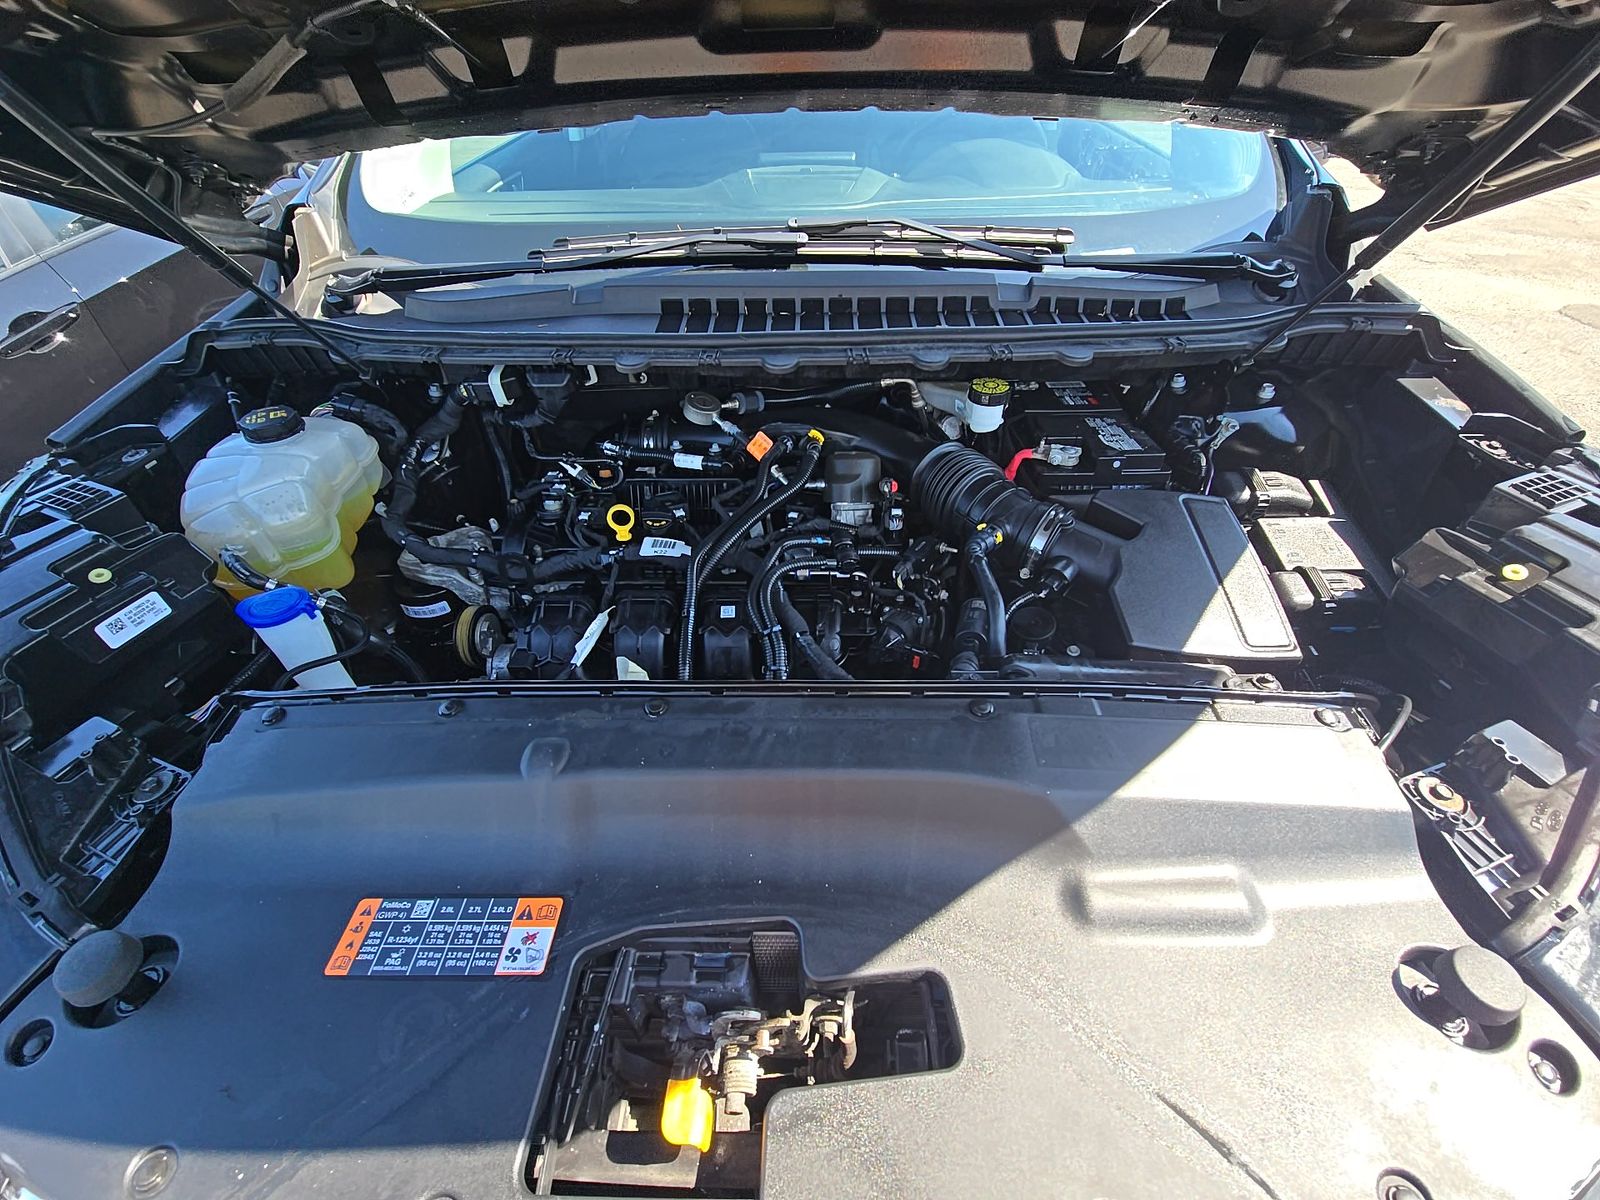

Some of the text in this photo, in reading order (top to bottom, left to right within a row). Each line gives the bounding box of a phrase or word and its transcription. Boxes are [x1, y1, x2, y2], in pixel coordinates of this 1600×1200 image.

[381, 901, 412, 909] FoMoCo
[375, 911, 407, 920] (GWP 4)
[445, 924, 453, 933] kg
[473, 924, 481, 933] kg
[500, 924, 508, 933] kg
[386, 936, 419, 945] R-1234yf
[384, 958, 402, 966] PAG
